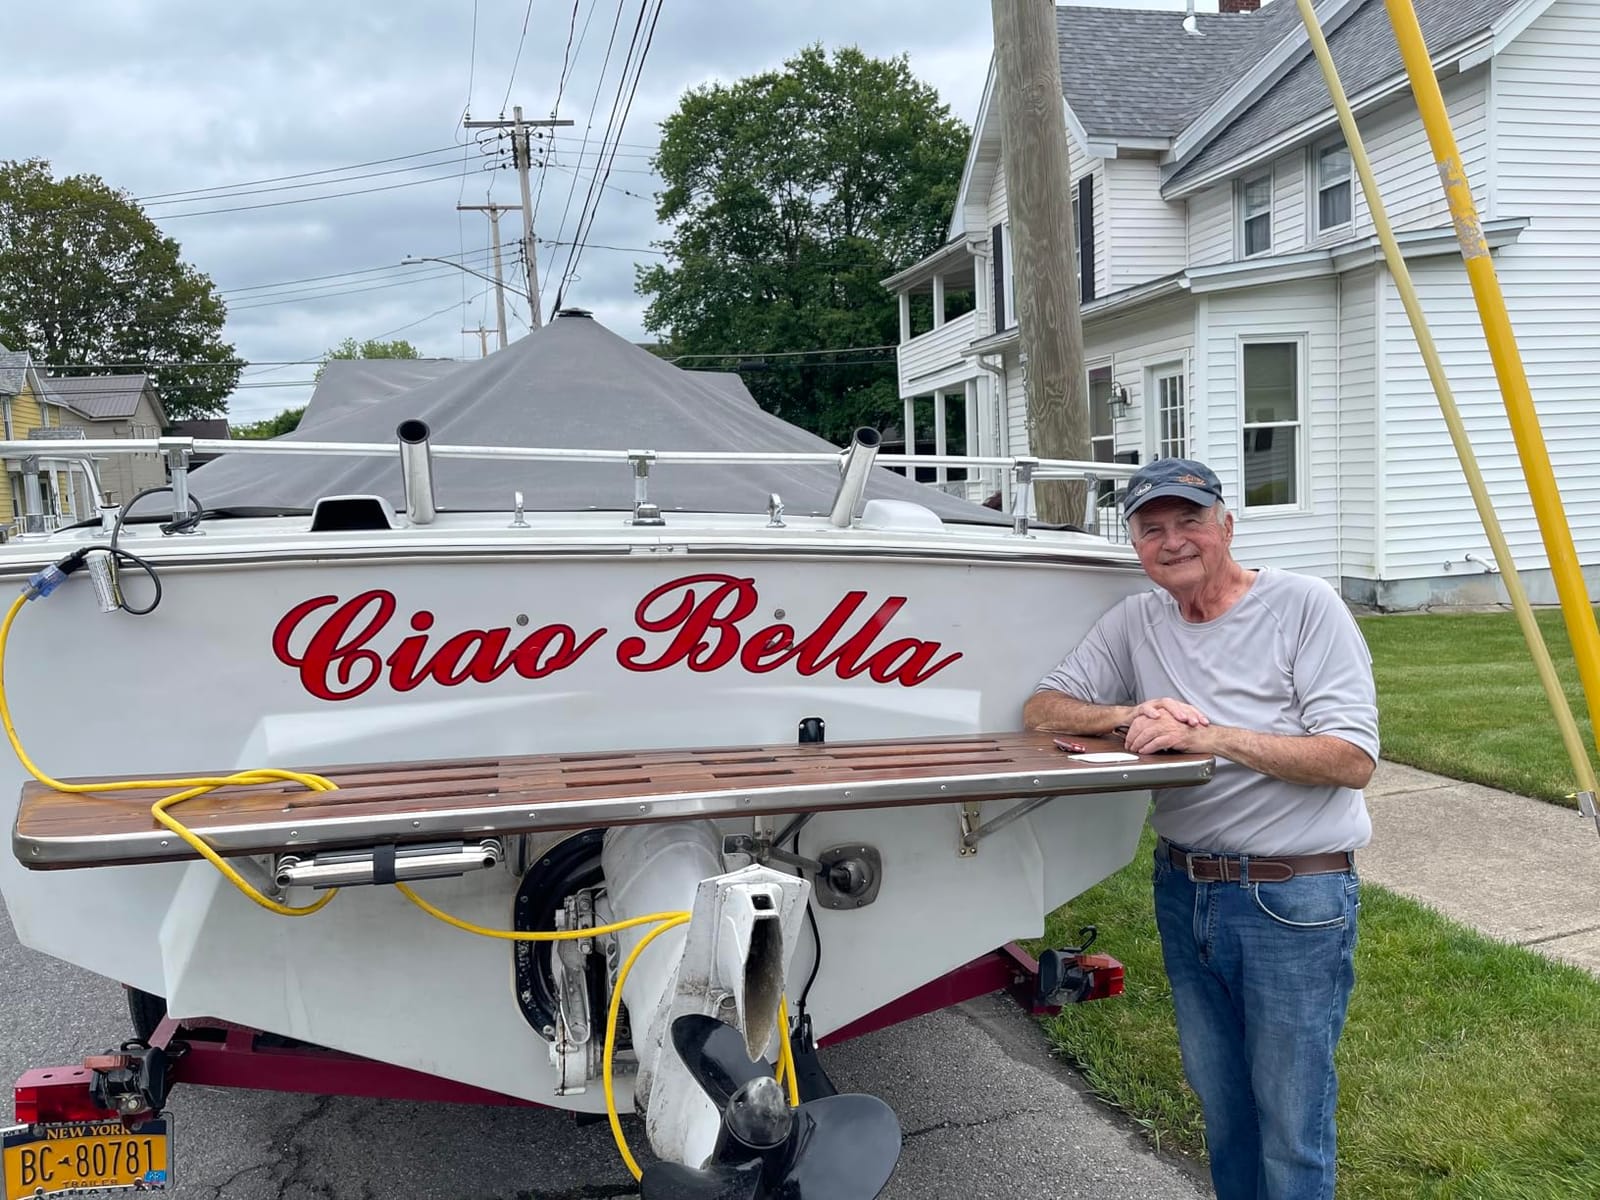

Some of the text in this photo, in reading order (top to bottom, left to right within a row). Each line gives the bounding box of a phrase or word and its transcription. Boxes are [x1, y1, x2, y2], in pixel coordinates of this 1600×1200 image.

[272, 573, 963, 701] Ciao Bella
[46, 1126, 86, 1140] NEW
[90, 1123, 132, 1136] YORK
[21, 1140, 153, 1186] BC 80781
[24, 1184, 165, 1200] ANHATTAN
